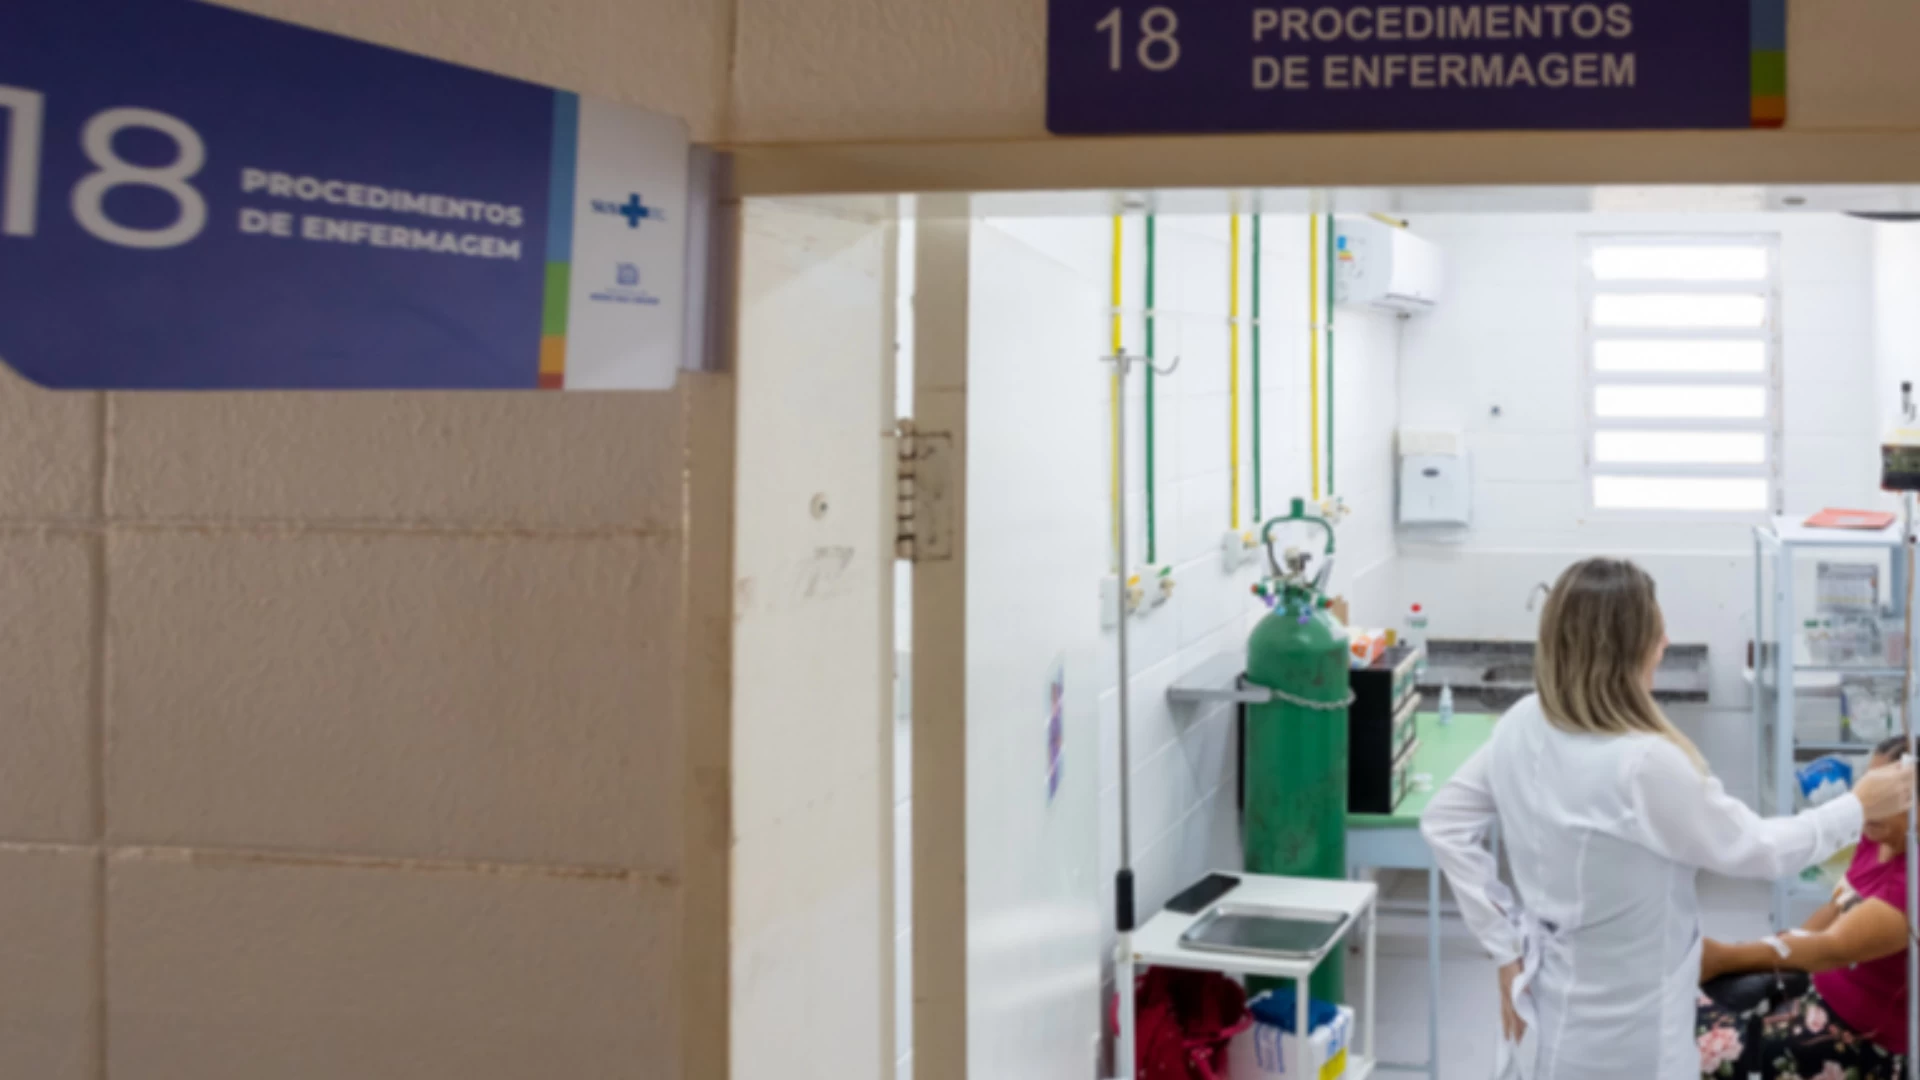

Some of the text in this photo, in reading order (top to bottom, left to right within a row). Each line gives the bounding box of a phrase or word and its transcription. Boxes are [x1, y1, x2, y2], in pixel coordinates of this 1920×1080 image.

[1095, 6, 1181, 71] 18
[1252, 3, 1633, 41] PROCEDIMENTOS
[1252, 53, 1636, 89] DE ENFERMAGEM
[0, 85, 208, 249] 18
[241, 167, 523, 228] PROCEDIMENTOS
[239, 208, 522, 261] DE ENFERMAGEM
